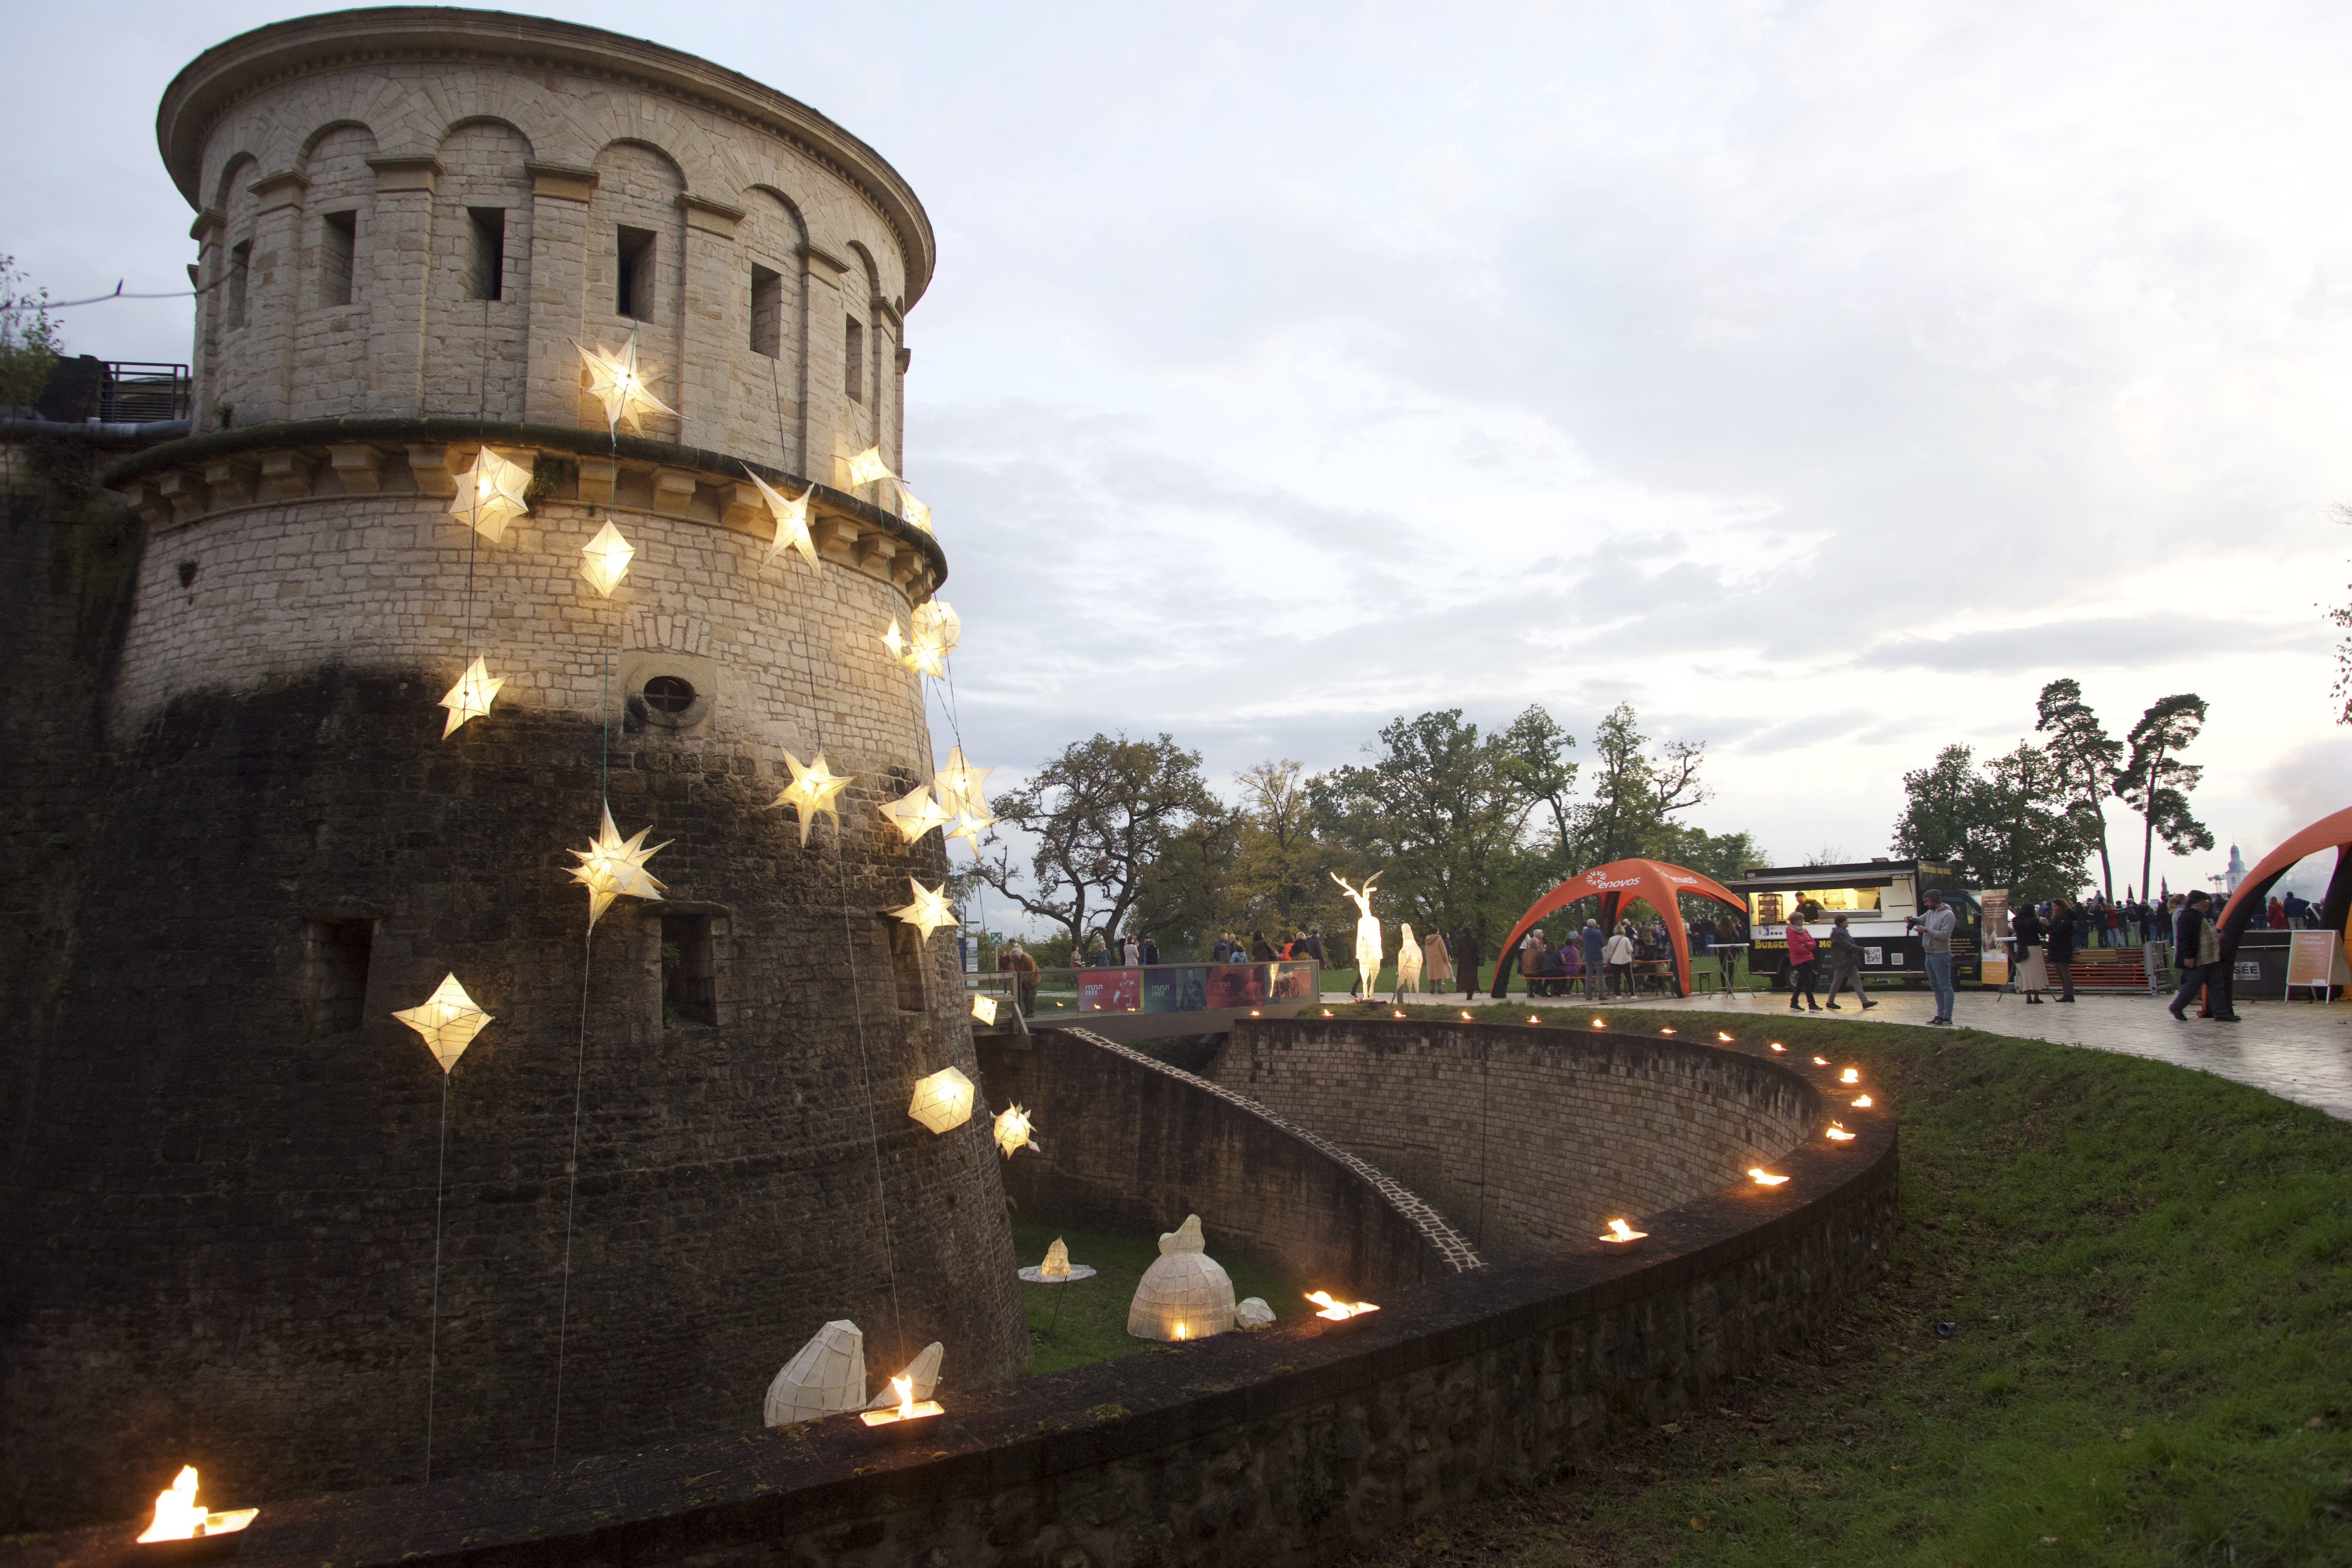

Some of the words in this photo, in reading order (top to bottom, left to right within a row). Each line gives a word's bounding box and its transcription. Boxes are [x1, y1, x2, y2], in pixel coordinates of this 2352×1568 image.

[1598, 877, 1641, 889] enovos
[1754, 940, 1789, 949] BURGER
[2233, 963, 2258, 974] SÉE
[1275, 971, 1293, 980] ANONÉIER
